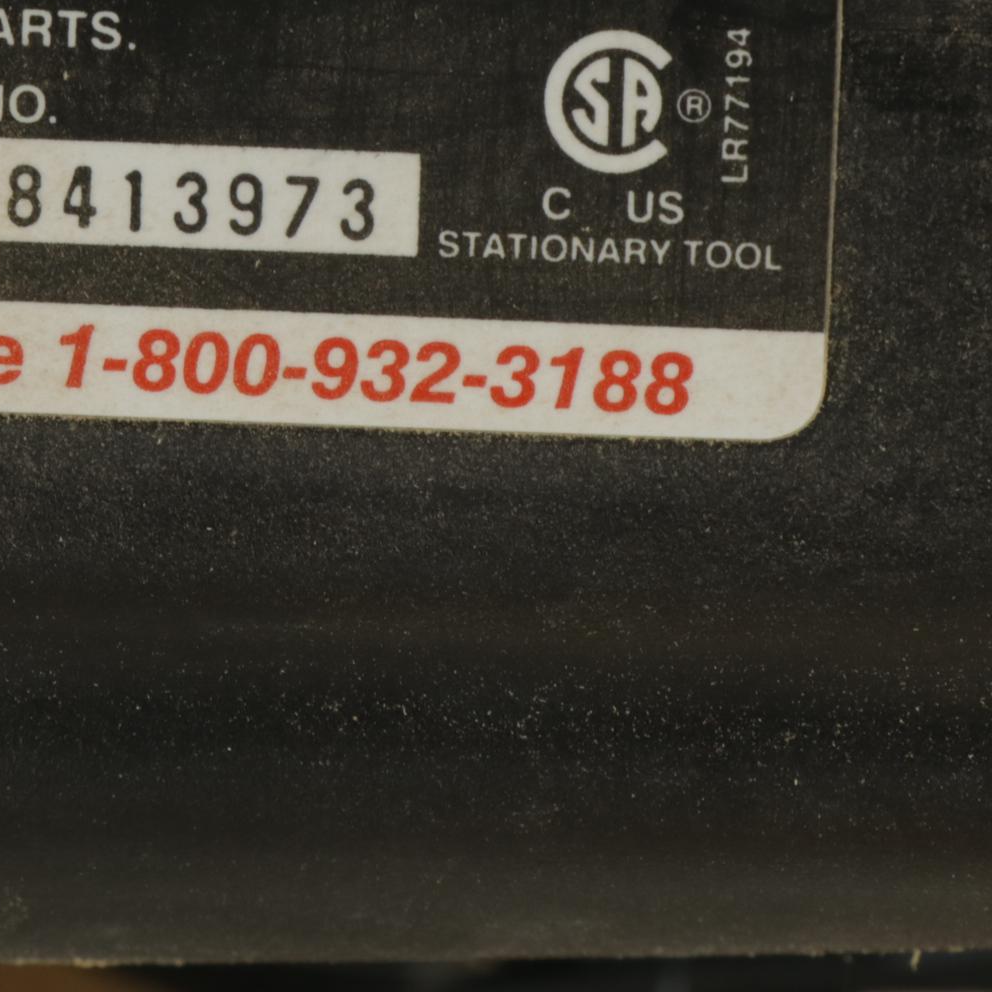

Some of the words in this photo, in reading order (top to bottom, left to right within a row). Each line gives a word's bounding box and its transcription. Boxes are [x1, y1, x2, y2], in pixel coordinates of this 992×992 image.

[720, 27, 754, 185] LR77194
[541, 186, 573, 221] C
[626, 190, 686, 225] US
[437, 230, 672, 266] STATIONARY
[684, 240, 783, 272] TOOL
[57, 322, 697, 418] 1-800-932-3188
